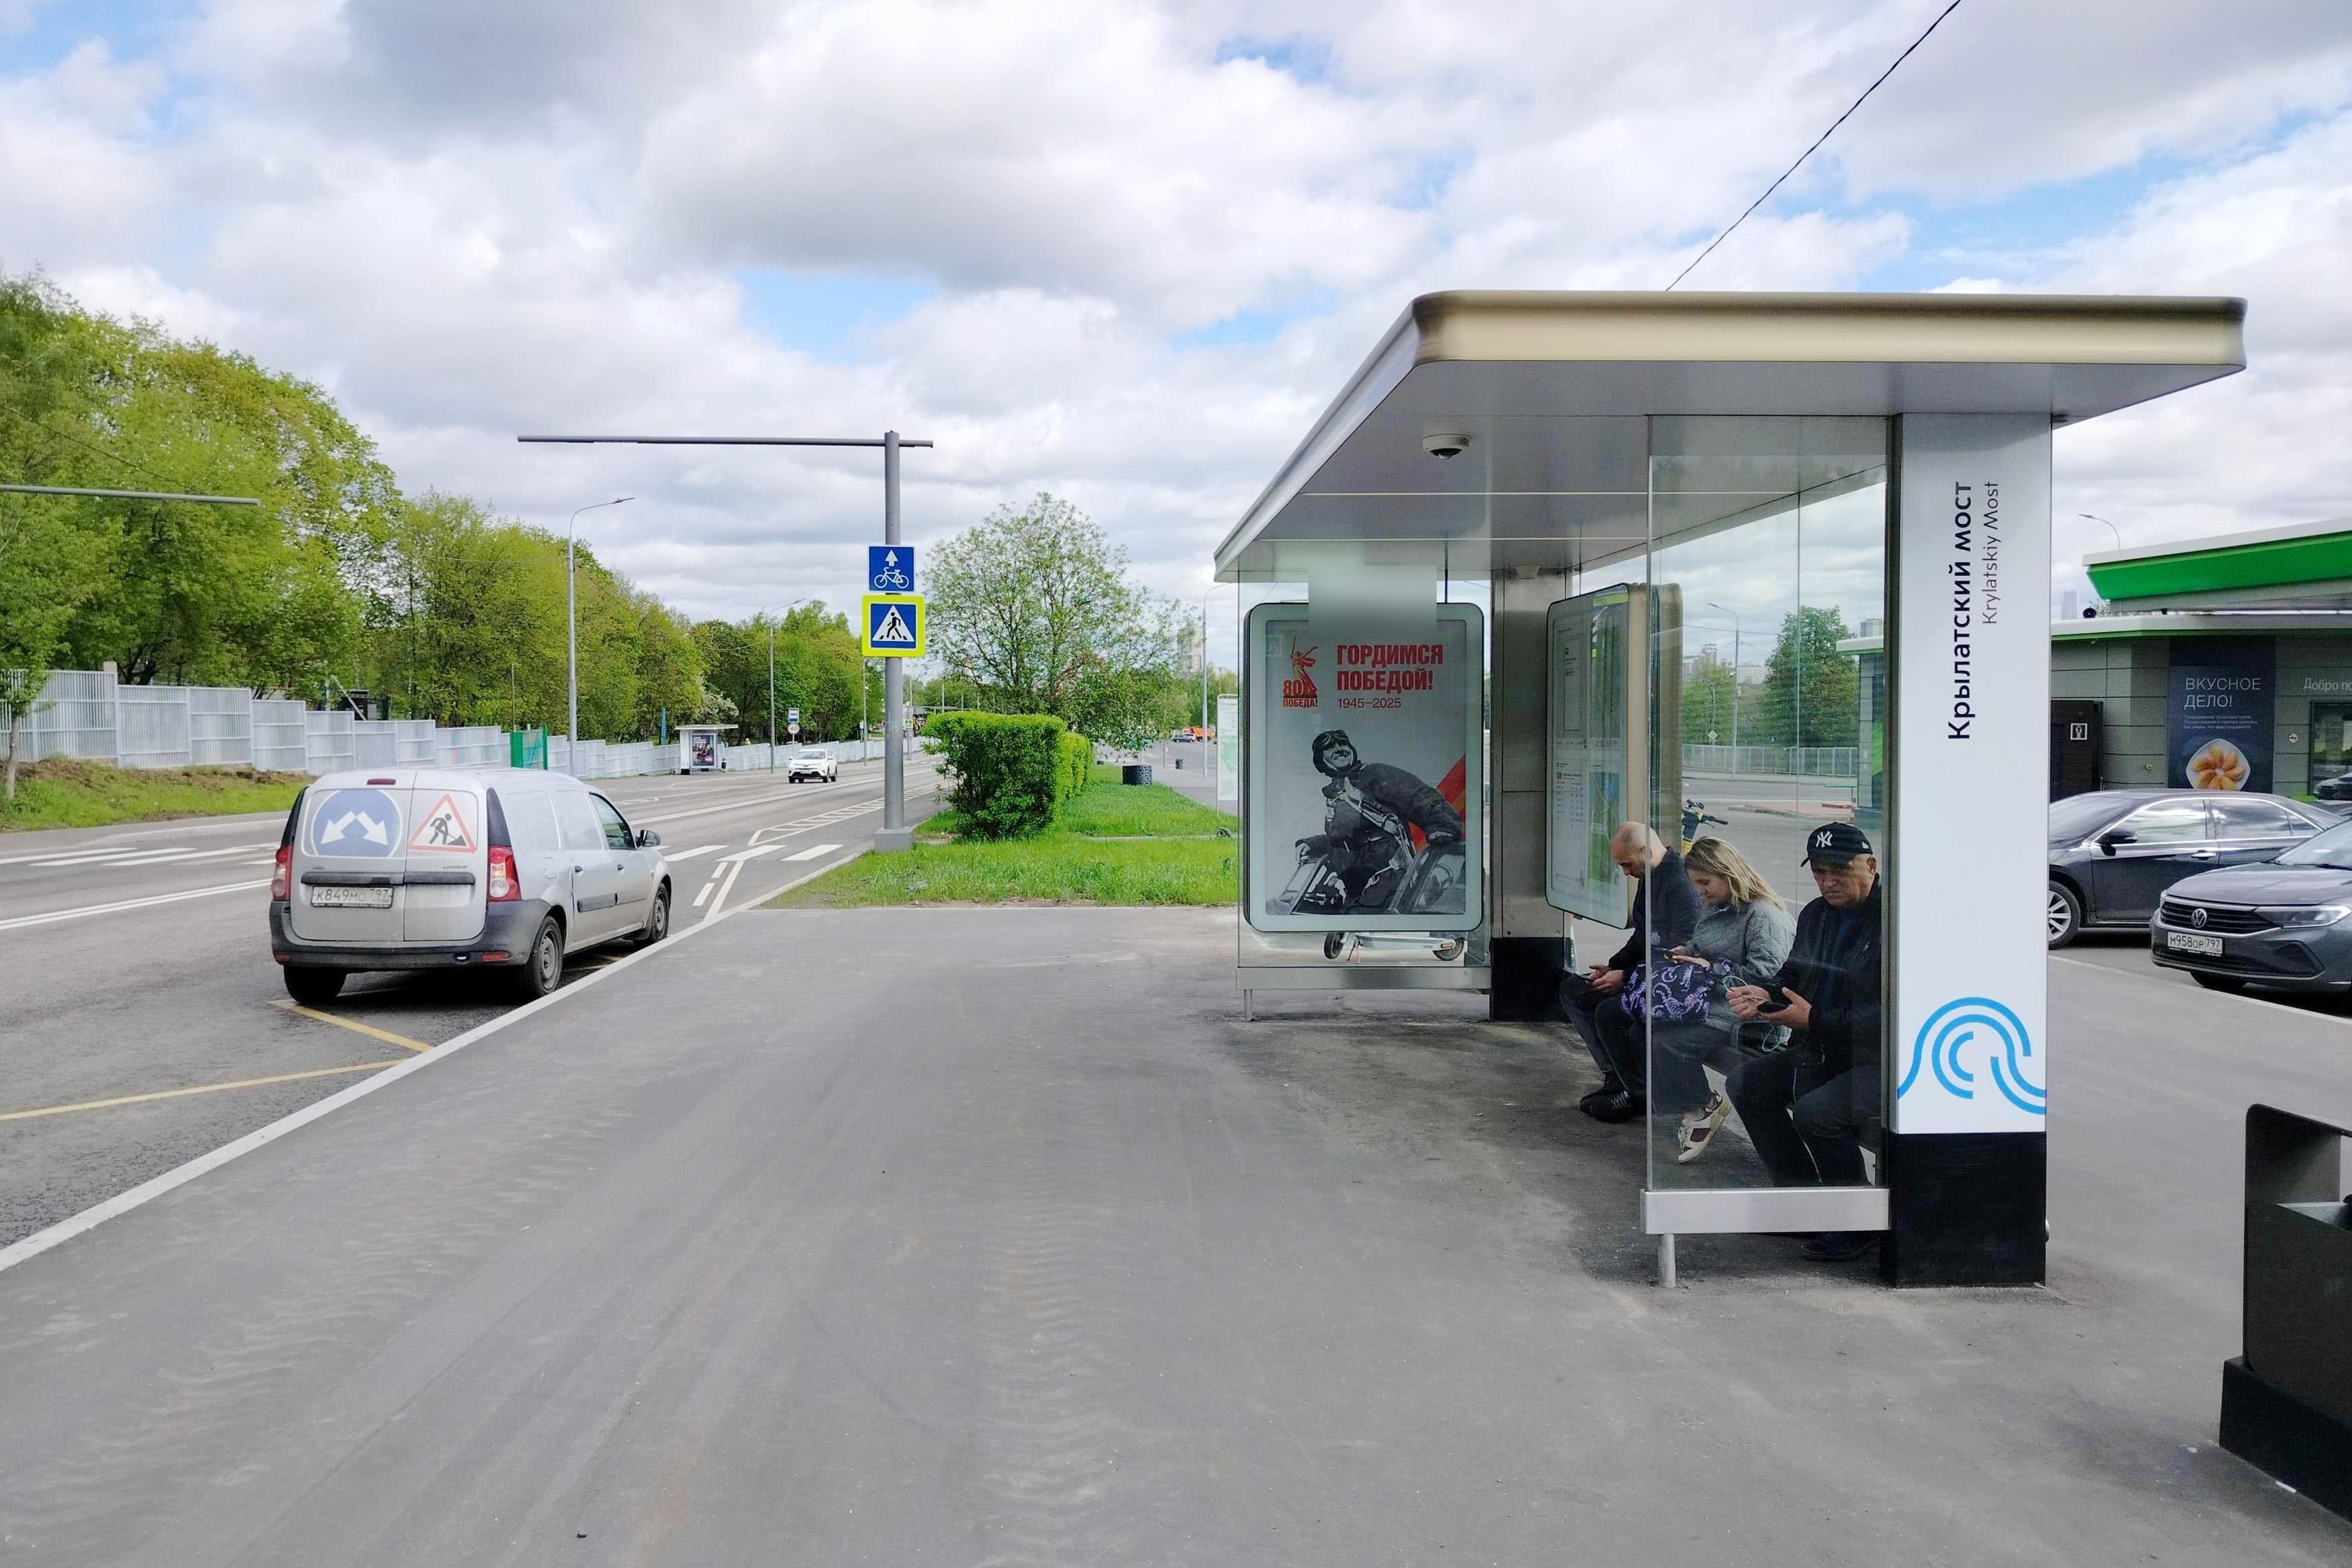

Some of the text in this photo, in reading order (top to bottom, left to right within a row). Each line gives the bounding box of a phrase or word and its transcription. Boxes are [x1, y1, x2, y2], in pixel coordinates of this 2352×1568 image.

[1982, 481, 2002, 624] Krylatskiy Most
[1948, 481, 1976, 740] Крылатский мост
[1337, 644, 1443, 668] ГОРДИМСЯ
[1337, 668, 1433, 693] ПОБЕДОЙ!
[2185, 678, 2261, 690] ВКУСНОЕ
[2303, 677, 2339, 693] Добро
[1283, 698, 1318, 708] ПОБЕДА!
[2183, 694, 2233, 710] ДЕЛО!
[1815, 830, 1833, 848] NY
